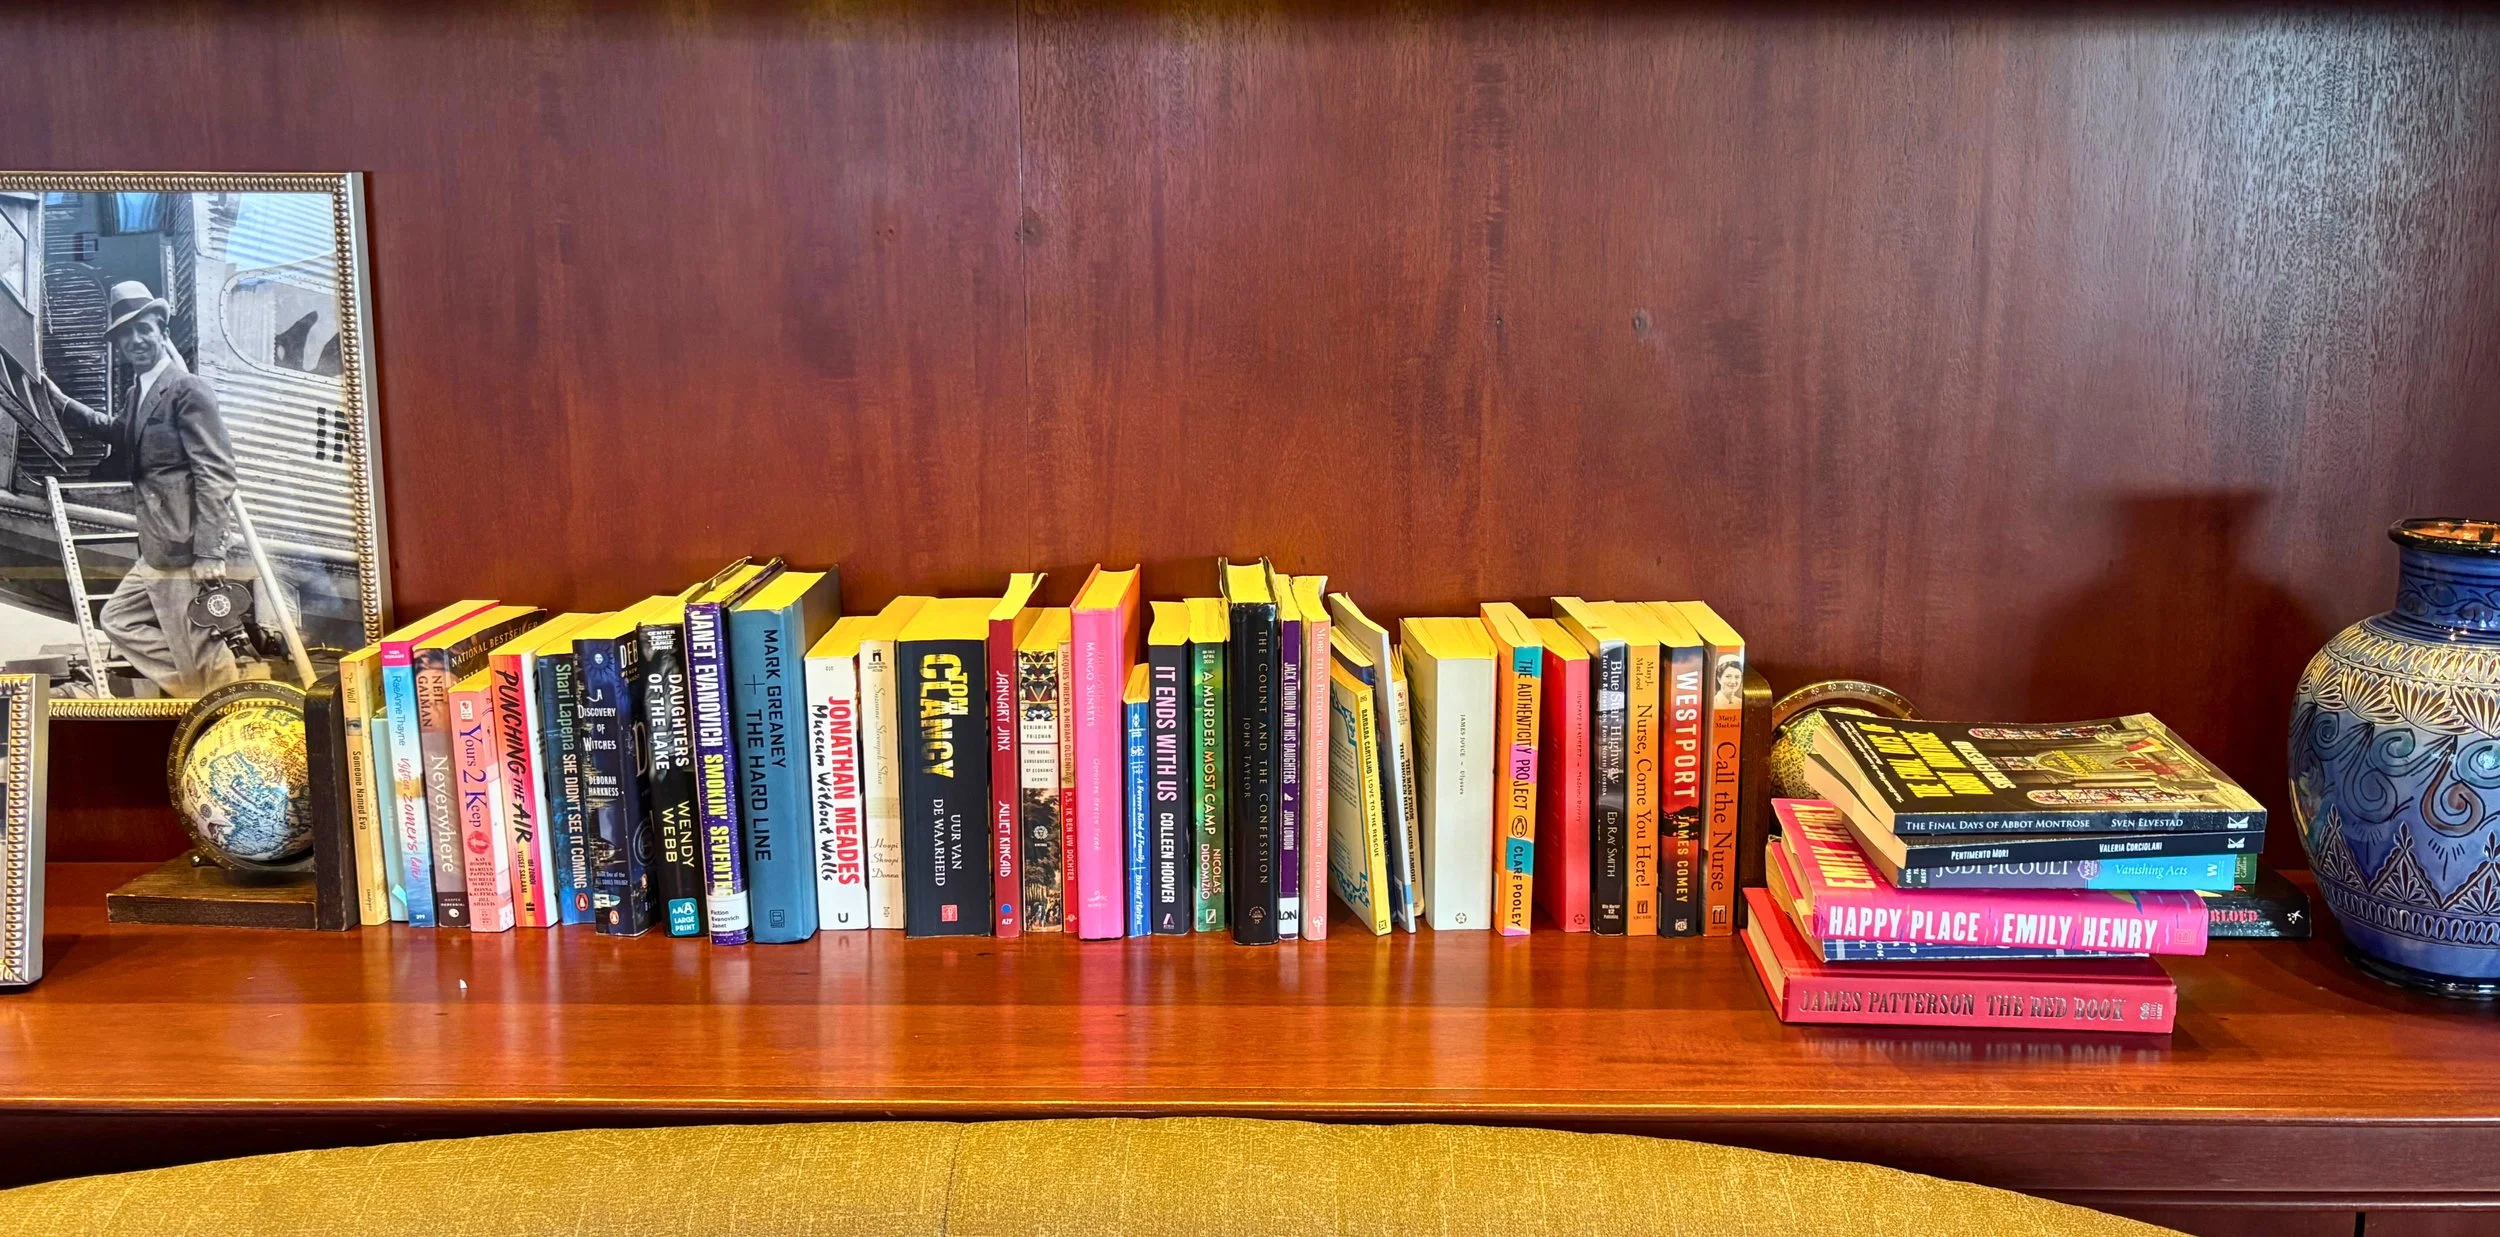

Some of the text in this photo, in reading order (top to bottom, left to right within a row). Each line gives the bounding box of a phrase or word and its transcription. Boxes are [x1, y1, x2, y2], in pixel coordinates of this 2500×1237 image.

[432, 676, 444, 702] NEIL
[764, 629, 786, 769] MARK GREANEY
[949, 672, 968, 716] TOM
[1086, 642, 1096, 727] MANGO SUNSETS
[1636, 657, 1644, 690] MacLeod
[392, 675, 406, 746] RaeAnne Thayne
[418, 676, 432, 728] GAIMAN
[648, 673, 670, 770] OF THE LAKE
[668, 674, 689, 767] DAUGHTERS
[919, 653, 961, 778] CLANCY
[995, 670, 1011, 752] JANUARY JINX
[1283, 662, 1297, 784] JACK LONDON AND HIS DAUGHTERS
[1608, 660, 1624, 784] Blue Star Highway
[460, 720, 483, 767] Yours
[495, 669, 532, 844] PUNCHING THE AIR
[828, 696, 855, 799] JONATHAN
[1156, 666, 1177, 802] IT ENDS WITH US
[1203, 671, 1216, 835] A MURDER MOST CAMP
[1243, 717, 1252, 798] JOHN TAYLOR
[1258, 629, 1269, 883] THE COUNT AND THE CONFESSION
[1513, 659, 1534, 810] THE AUTHENTICITY PROJECT
[1674, 670, 1698, 798] WESTPORT
[1867, 735, 1916, 755] DAYS
[353, 751, 368, 830] Someone Named Eva
[463, 769, 487, 783] 2
[556, 663, 588, 889] Shari Lapena SHE DIDN'T SEE IT COMING
[589, 776, 617, 785] DEBORAH
[746, 709, 771, 861] THE HARD LINE
[1887, 758, 1938, 780] FINAL
[1899, 730, 1994, 795] ABBOT MONTROSE
[1906, 782, 1954, 798] THE
[431, 755, 457, 872] Neverwhere
[464, 791, 487, 828] Keep
[588, 787, 620, 797] HARKNESS
[812, 704, 838, 881] Museum Without Walls
[1370, 800, 1376, 811] TO
[1633, 704, 1653, 887] Nurse, Come You Here!
[1711, 741, 1737, 891] Call the Nurse
[662, 807, 678, 863] WEBB
[677, 800, 696, 868] WENDY
[835, 807, 860, 884] MEADES
[933, 799, 946, 886] DE WAARHEID
[950, 814, 962, 870] UUR VAN
[999, 801, 1012, 878] JULIET KINCAID
[1065, 791, 1075, 880] P.S. IK BEN UW DOCHTER
[1284, 810, 1295, 851] JOAN LONDON
[1372, 829, 1380, 858] RESCUE
[1607, 811, 1618, 877] ED RAY SMITH
[1677, 815, 1690, 855] JAMES
[1790, 803, 1854, 843] HENRY
[1905, 821, 1926, 830] THE
[1928, 821, 1957, 830] FINAL
[1959, 821, 1984, 829] DAYS
[2001, 820, 2033, 829] ABBOT
[2035, 819, 2090, 828] MONTROSE
[2099, 841, 2163, 853] VALERIA CORCIOLANI
[2111, 817, 2184, 828] SVEN ELVESTAD
[871, 867, 899, 879] Donna
[1160, 812, 1175, 903] COLLEEN HOOVER
[1201, 844, 1211, 900] DIDOMIZIO
[1213, 849, 1222, 894] NICOLAS
[1676, 860, 1689, 903] COMEY
[1810, 845, 1876, 888] EMILY
[1951, 848, 2009, 860] PENTIMENTO MORI
[2115, 863, 2164, 879] Vanishing
[2167, 864, 2188, 876] Acts
[1511, 846, 1524, 927] CLARE POOLEY
[674, 916, 695, 924] LARGE
[1828, 906, 1981, 941] HAPPY PLACE
[2002, 913, 2158, 949] EMILY HENRY
[1799, 990, 1975, 1015] JAMES PATTERSON
[1986, 995, 2024, 1017] THE
[2029, 997, 2069, 1019] RED
[2073, 997, 2126, 1022] BOOK
